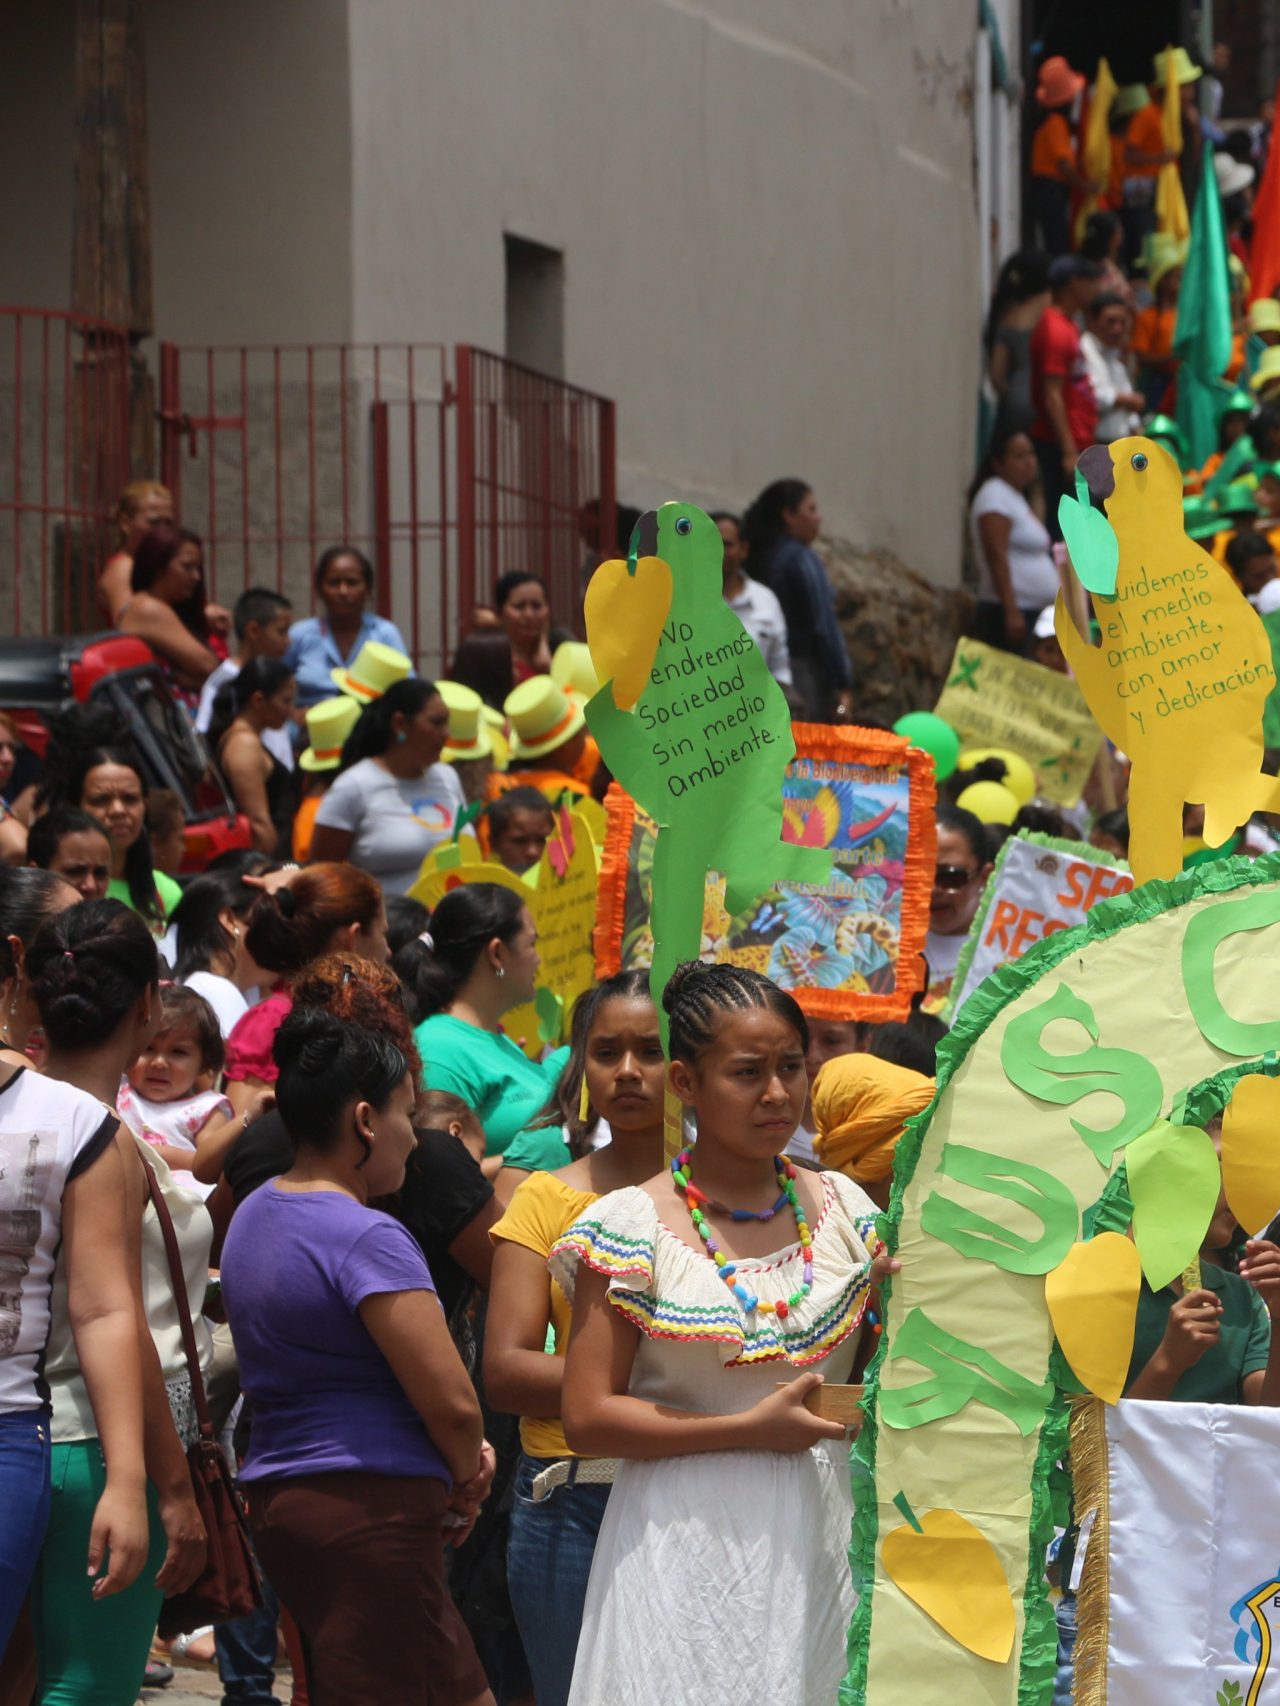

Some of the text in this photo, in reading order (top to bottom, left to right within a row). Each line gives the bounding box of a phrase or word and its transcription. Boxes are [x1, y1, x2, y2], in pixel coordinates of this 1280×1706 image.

[658, 621, 694, 647] No
[1107, 587, 1213, 639] el medio
[650, 631, 754, 685] endremos
[1107, 615, 1224, 668] ambiente,
[1116, 671, 1155, 699] con
[1160, 640, 1223, 677] amor
[639, 664, 745, 731] Sociedad
[1155, 658, 1275, 718] dedicación.
[652, 696, 766, 766] Sin medio
